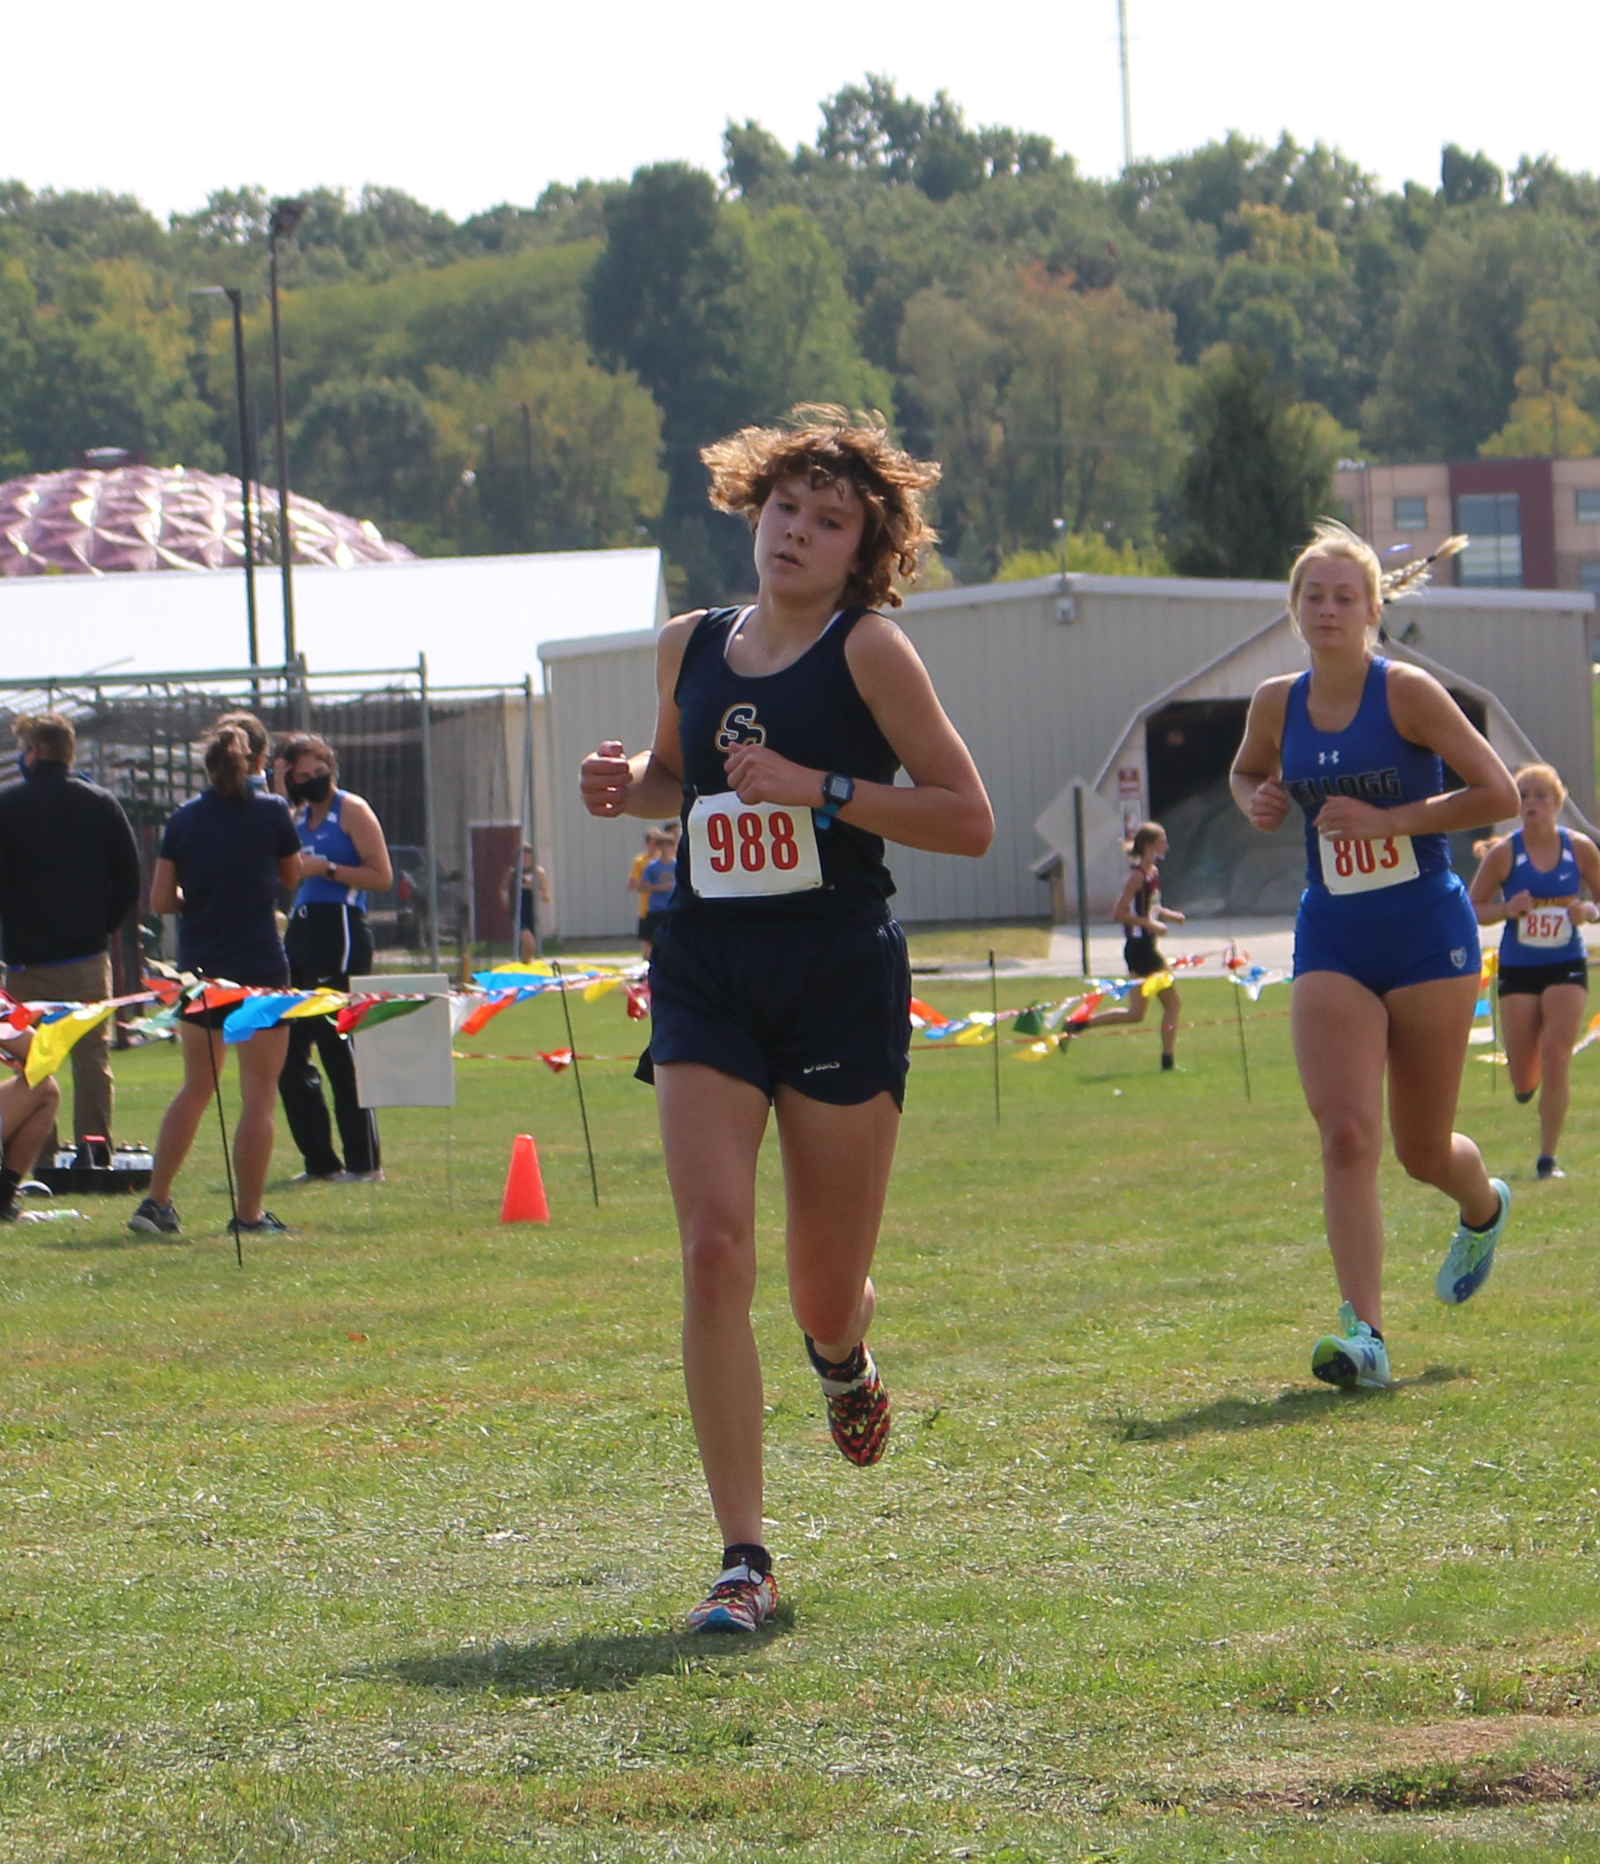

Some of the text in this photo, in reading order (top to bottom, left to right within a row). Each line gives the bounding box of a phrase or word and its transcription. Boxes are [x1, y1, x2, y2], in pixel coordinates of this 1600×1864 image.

[1285, 767, 1402, 806] ELLOGG
[707, 811, 799, 873] 988
[1333, 836, 1399, 877] 803
[1527, 914, 1564, 938] 857
